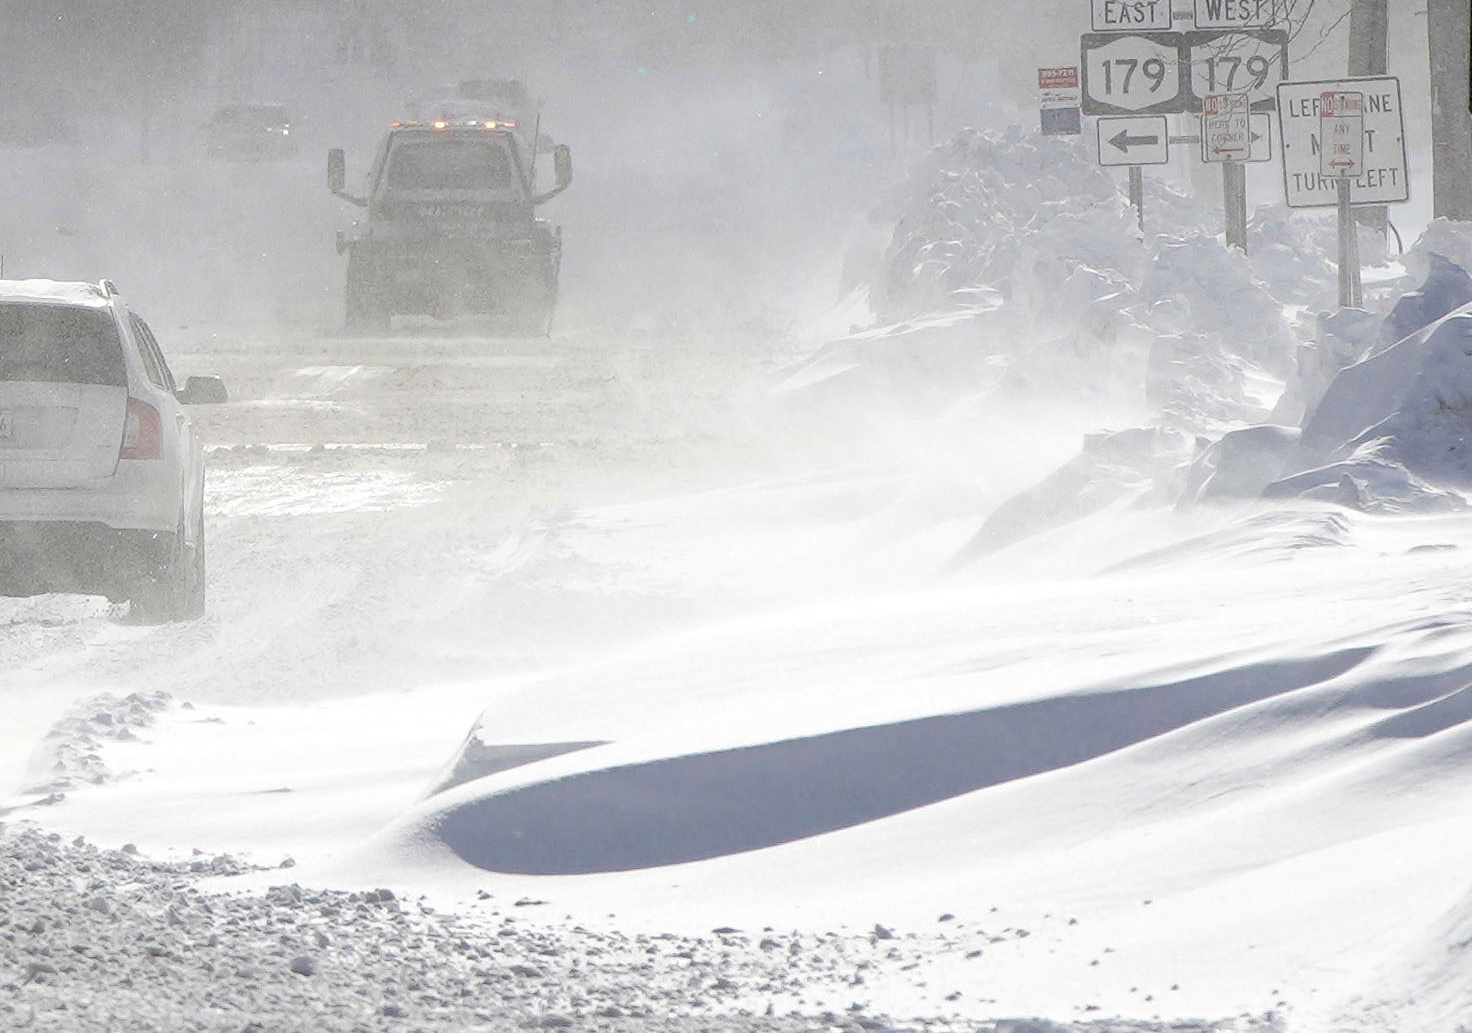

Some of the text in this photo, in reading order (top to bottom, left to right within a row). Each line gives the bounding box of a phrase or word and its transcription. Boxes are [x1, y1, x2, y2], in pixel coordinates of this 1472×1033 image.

[1103, 0, 1157, 24] EAST
[1101, 57, 1165, 95] 179
[1207, 55, 1269, 92] 179
[1334, 123, 1350, 135] ANY
